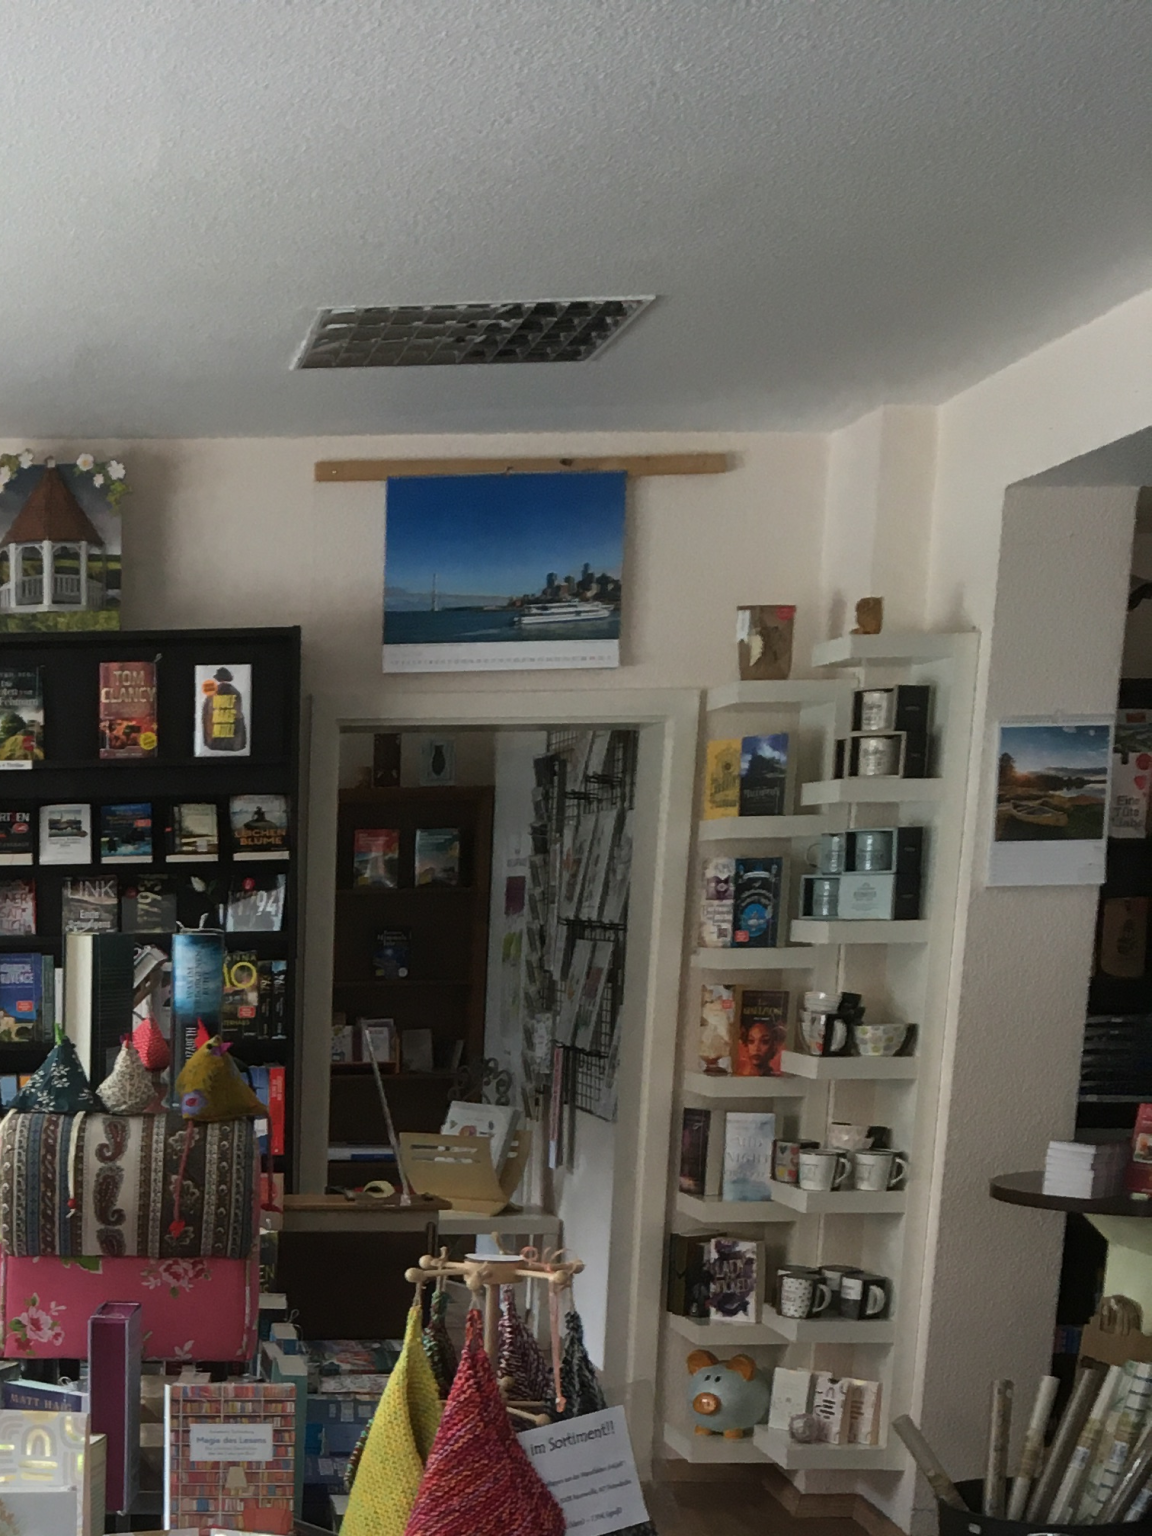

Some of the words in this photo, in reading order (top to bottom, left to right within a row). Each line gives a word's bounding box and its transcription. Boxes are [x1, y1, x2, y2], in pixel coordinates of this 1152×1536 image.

[113, 671, 145, 686] TOM
[100, 688, 157, 703] CLANCY
[239, 837, 283, 846] BLUME
[68, 880, 115, 898] LINK
[10, 1393, 39, 1407] MATT
[197, 1436, 219, 1446] Magie
[223, 1436, 237, 1444] des
[529, 1444, 546, 1457] im
[548, 1420, 617, 1453] Sortiment!!
